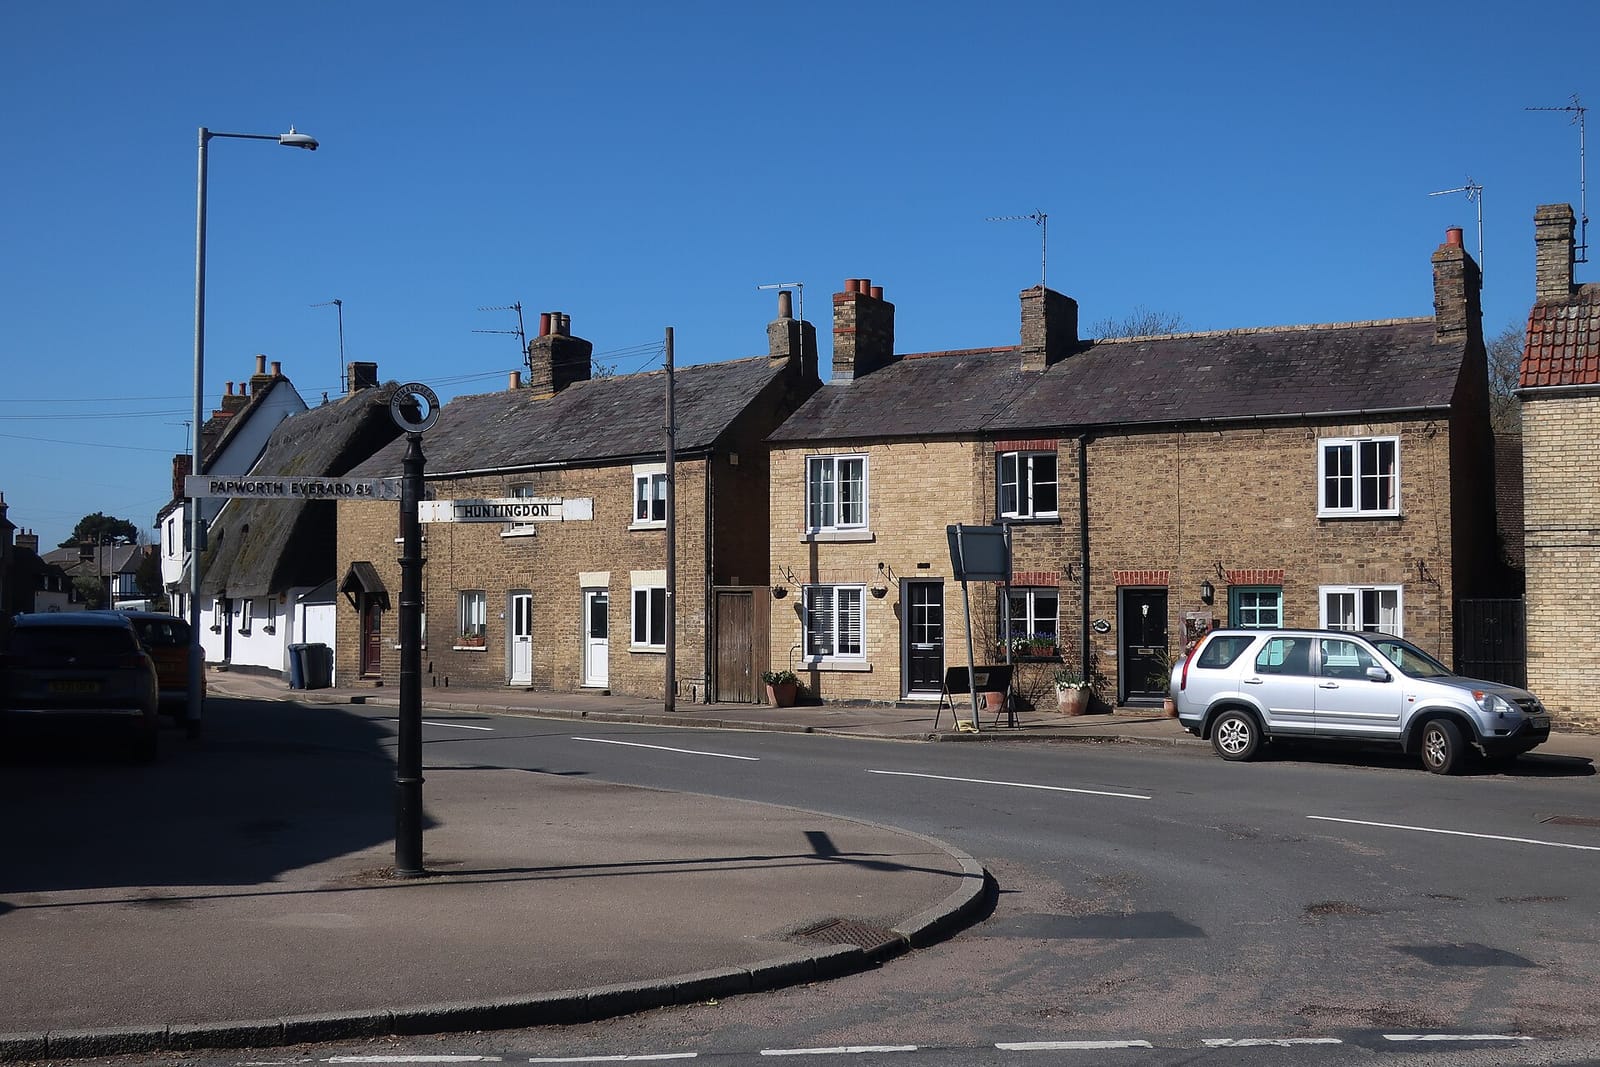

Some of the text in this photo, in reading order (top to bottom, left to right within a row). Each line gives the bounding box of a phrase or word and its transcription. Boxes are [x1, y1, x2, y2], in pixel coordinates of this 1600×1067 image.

[210, 481, 283, 495] PAPWORTH
[291, 482, 351, 495] EVERARD
[464, 504, 549, 518] HUNTINGDON
